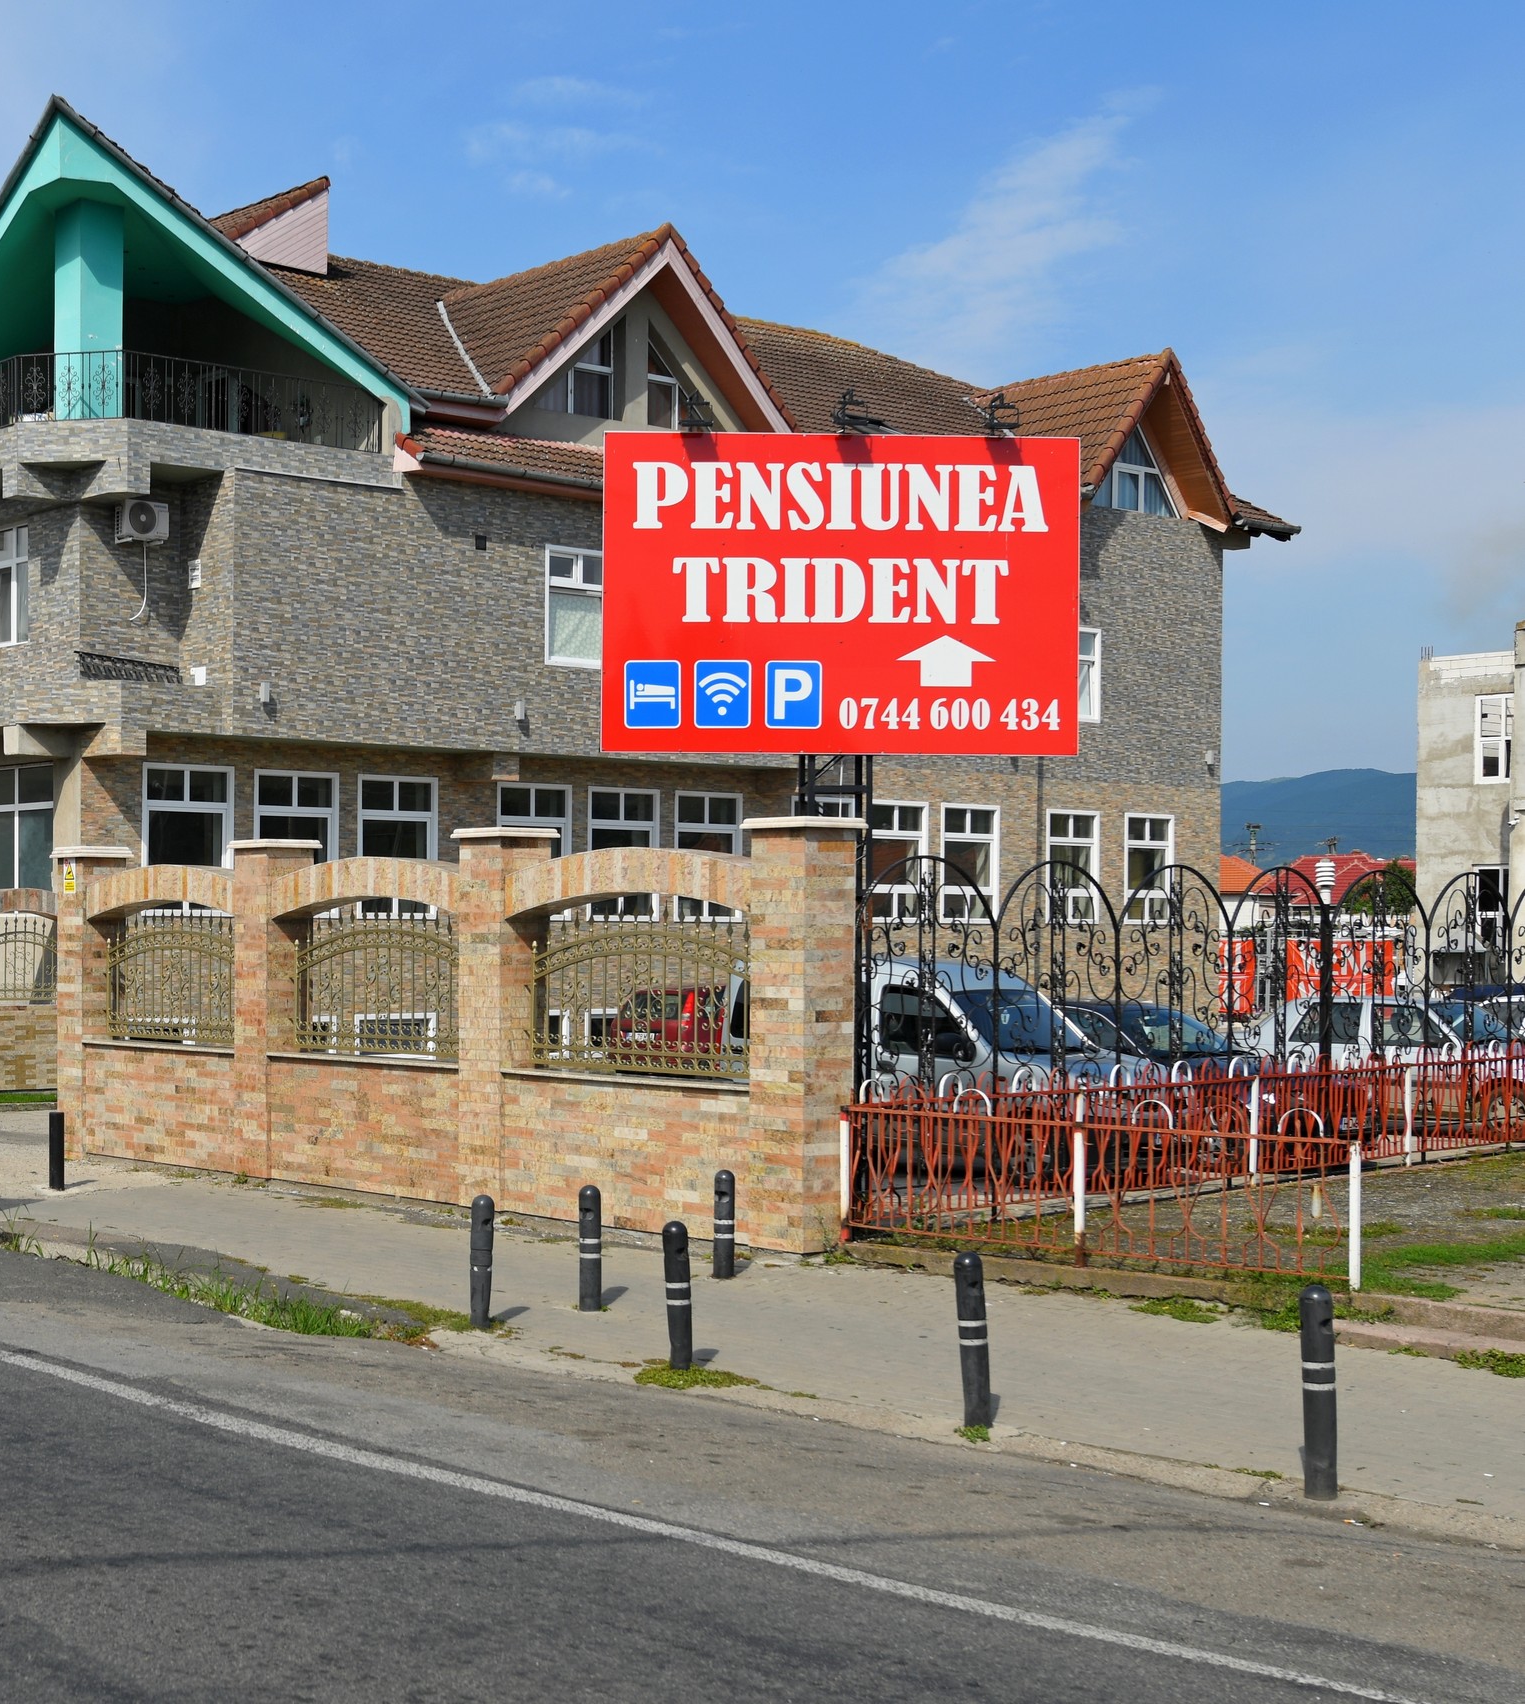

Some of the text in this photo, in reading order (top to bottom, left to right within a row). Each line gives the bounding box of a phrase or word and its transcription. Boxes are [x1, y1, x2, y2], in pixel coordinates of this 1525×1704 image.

[632, 461, 1049, 533] PENSIUNEA
[672, 557, 1009, 625] TRIDENT
[839, 697, 1061, 731] 0744 600 434
